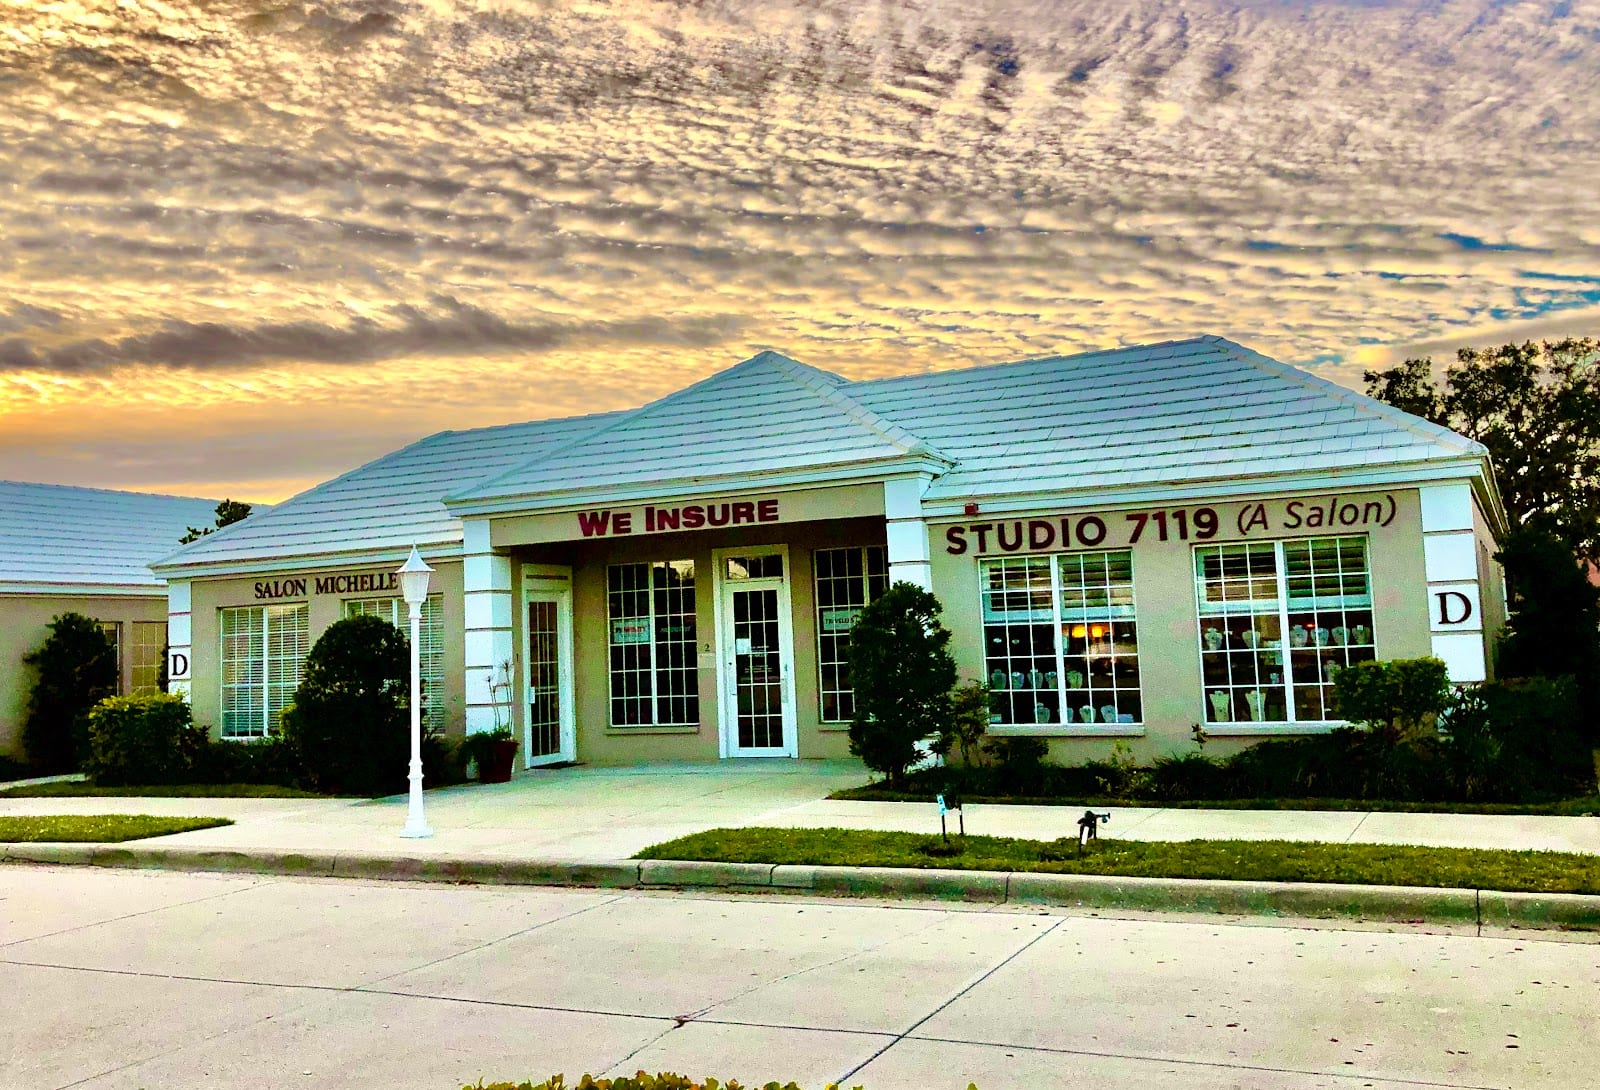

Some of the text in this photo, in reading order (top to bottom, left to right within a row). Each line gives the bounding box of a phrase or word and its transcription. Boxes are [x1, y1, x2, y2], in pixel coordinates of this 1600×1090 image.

[945, 495, 1397, 555] STUDIO 7119 (A Salon)
[254, 572, 399, 599] SALON MICHELLE
[1434, 591, 1472, 625] D
[171, 653, 189, 676] D
